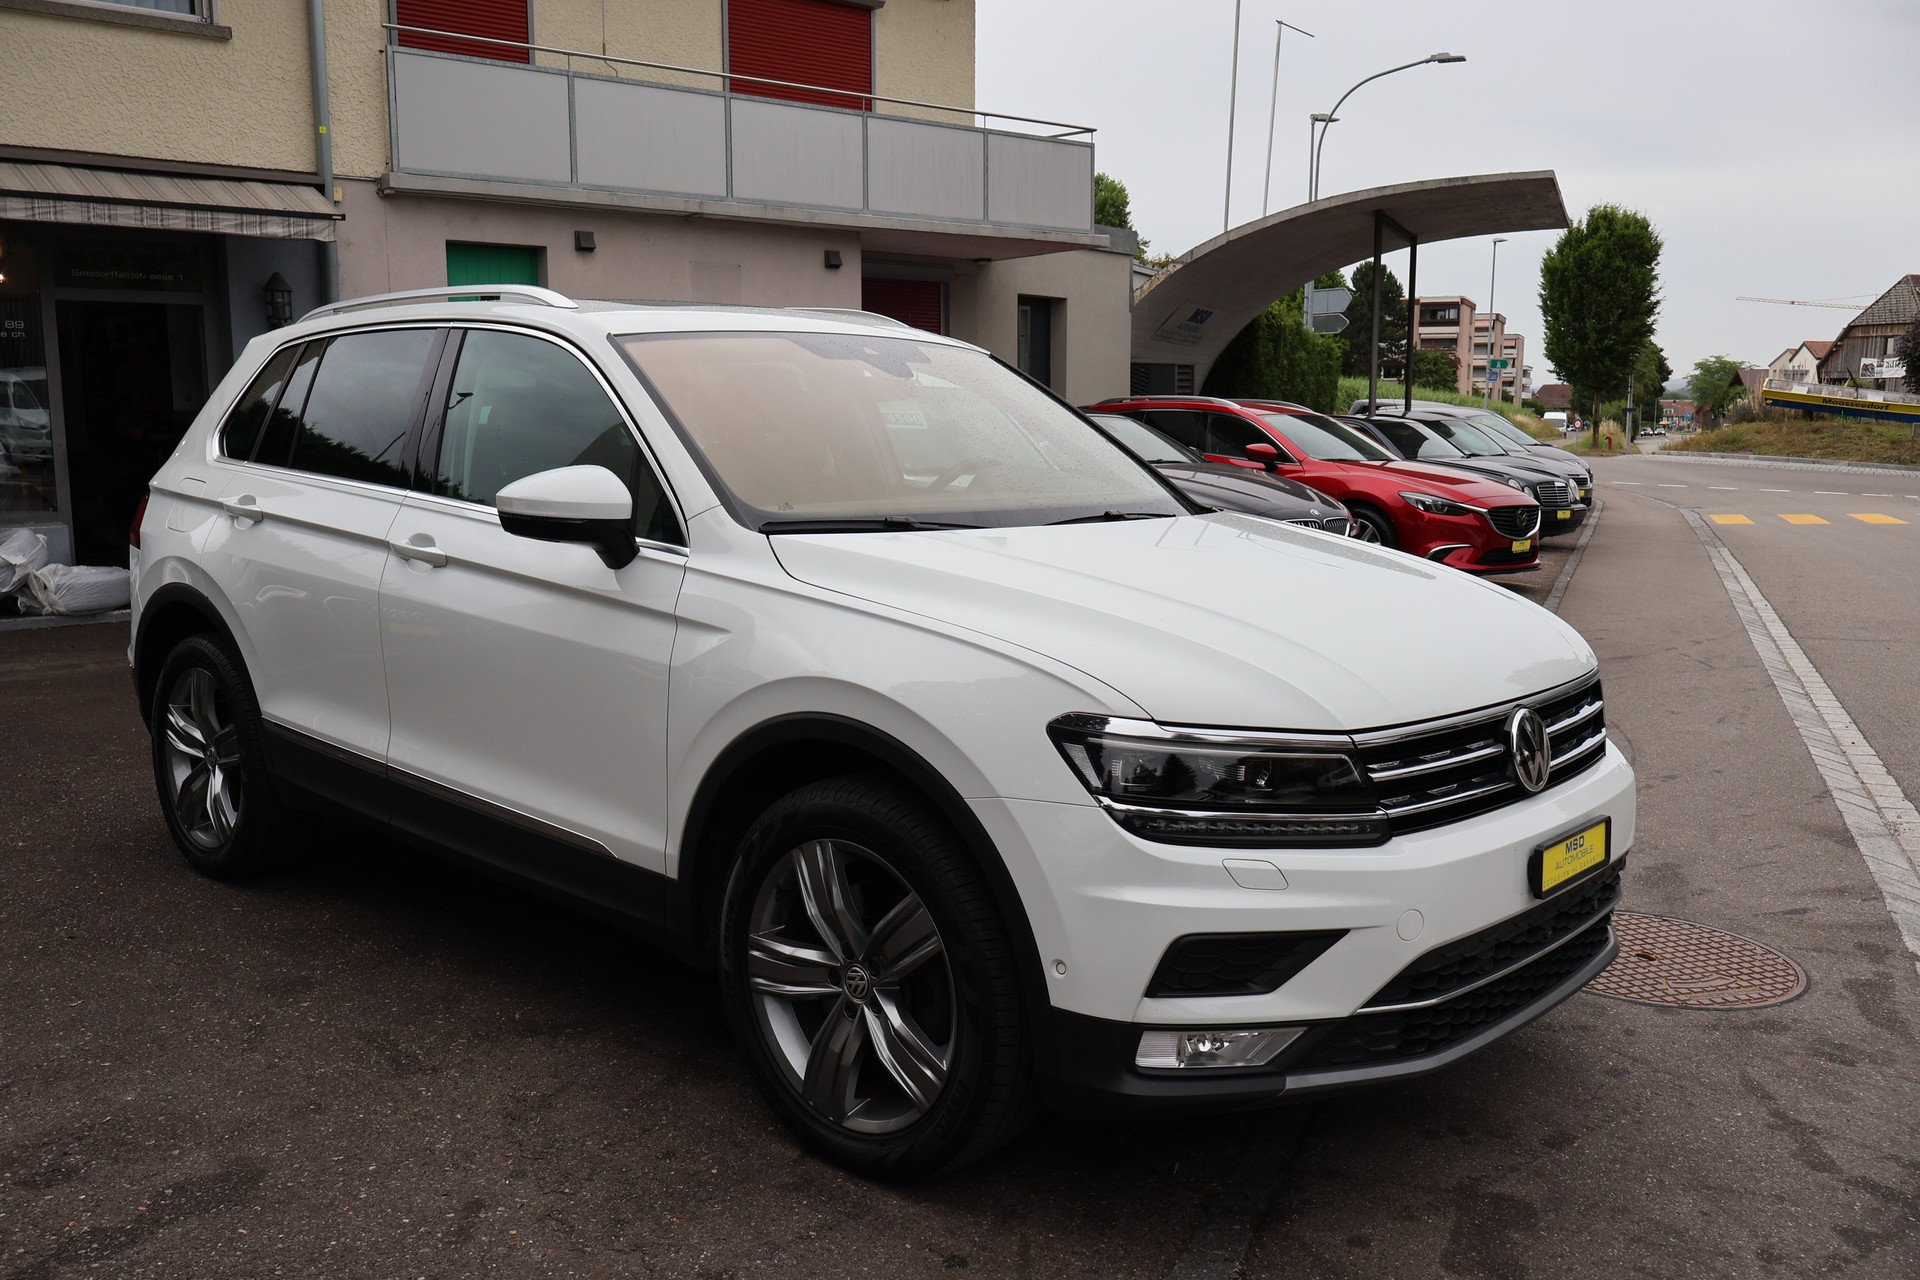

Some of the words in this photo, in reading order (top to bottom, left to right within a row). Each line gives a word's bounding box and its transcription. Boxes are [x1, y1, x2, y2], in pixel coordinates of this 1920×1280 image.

[5, 320, 25, 329] 89
[1822, 398, 1889, 411] Moosseedorf
[1565, 834, 1585, 855] MSD
[1554, 844, 1594, 870] AUTOMOBILE
